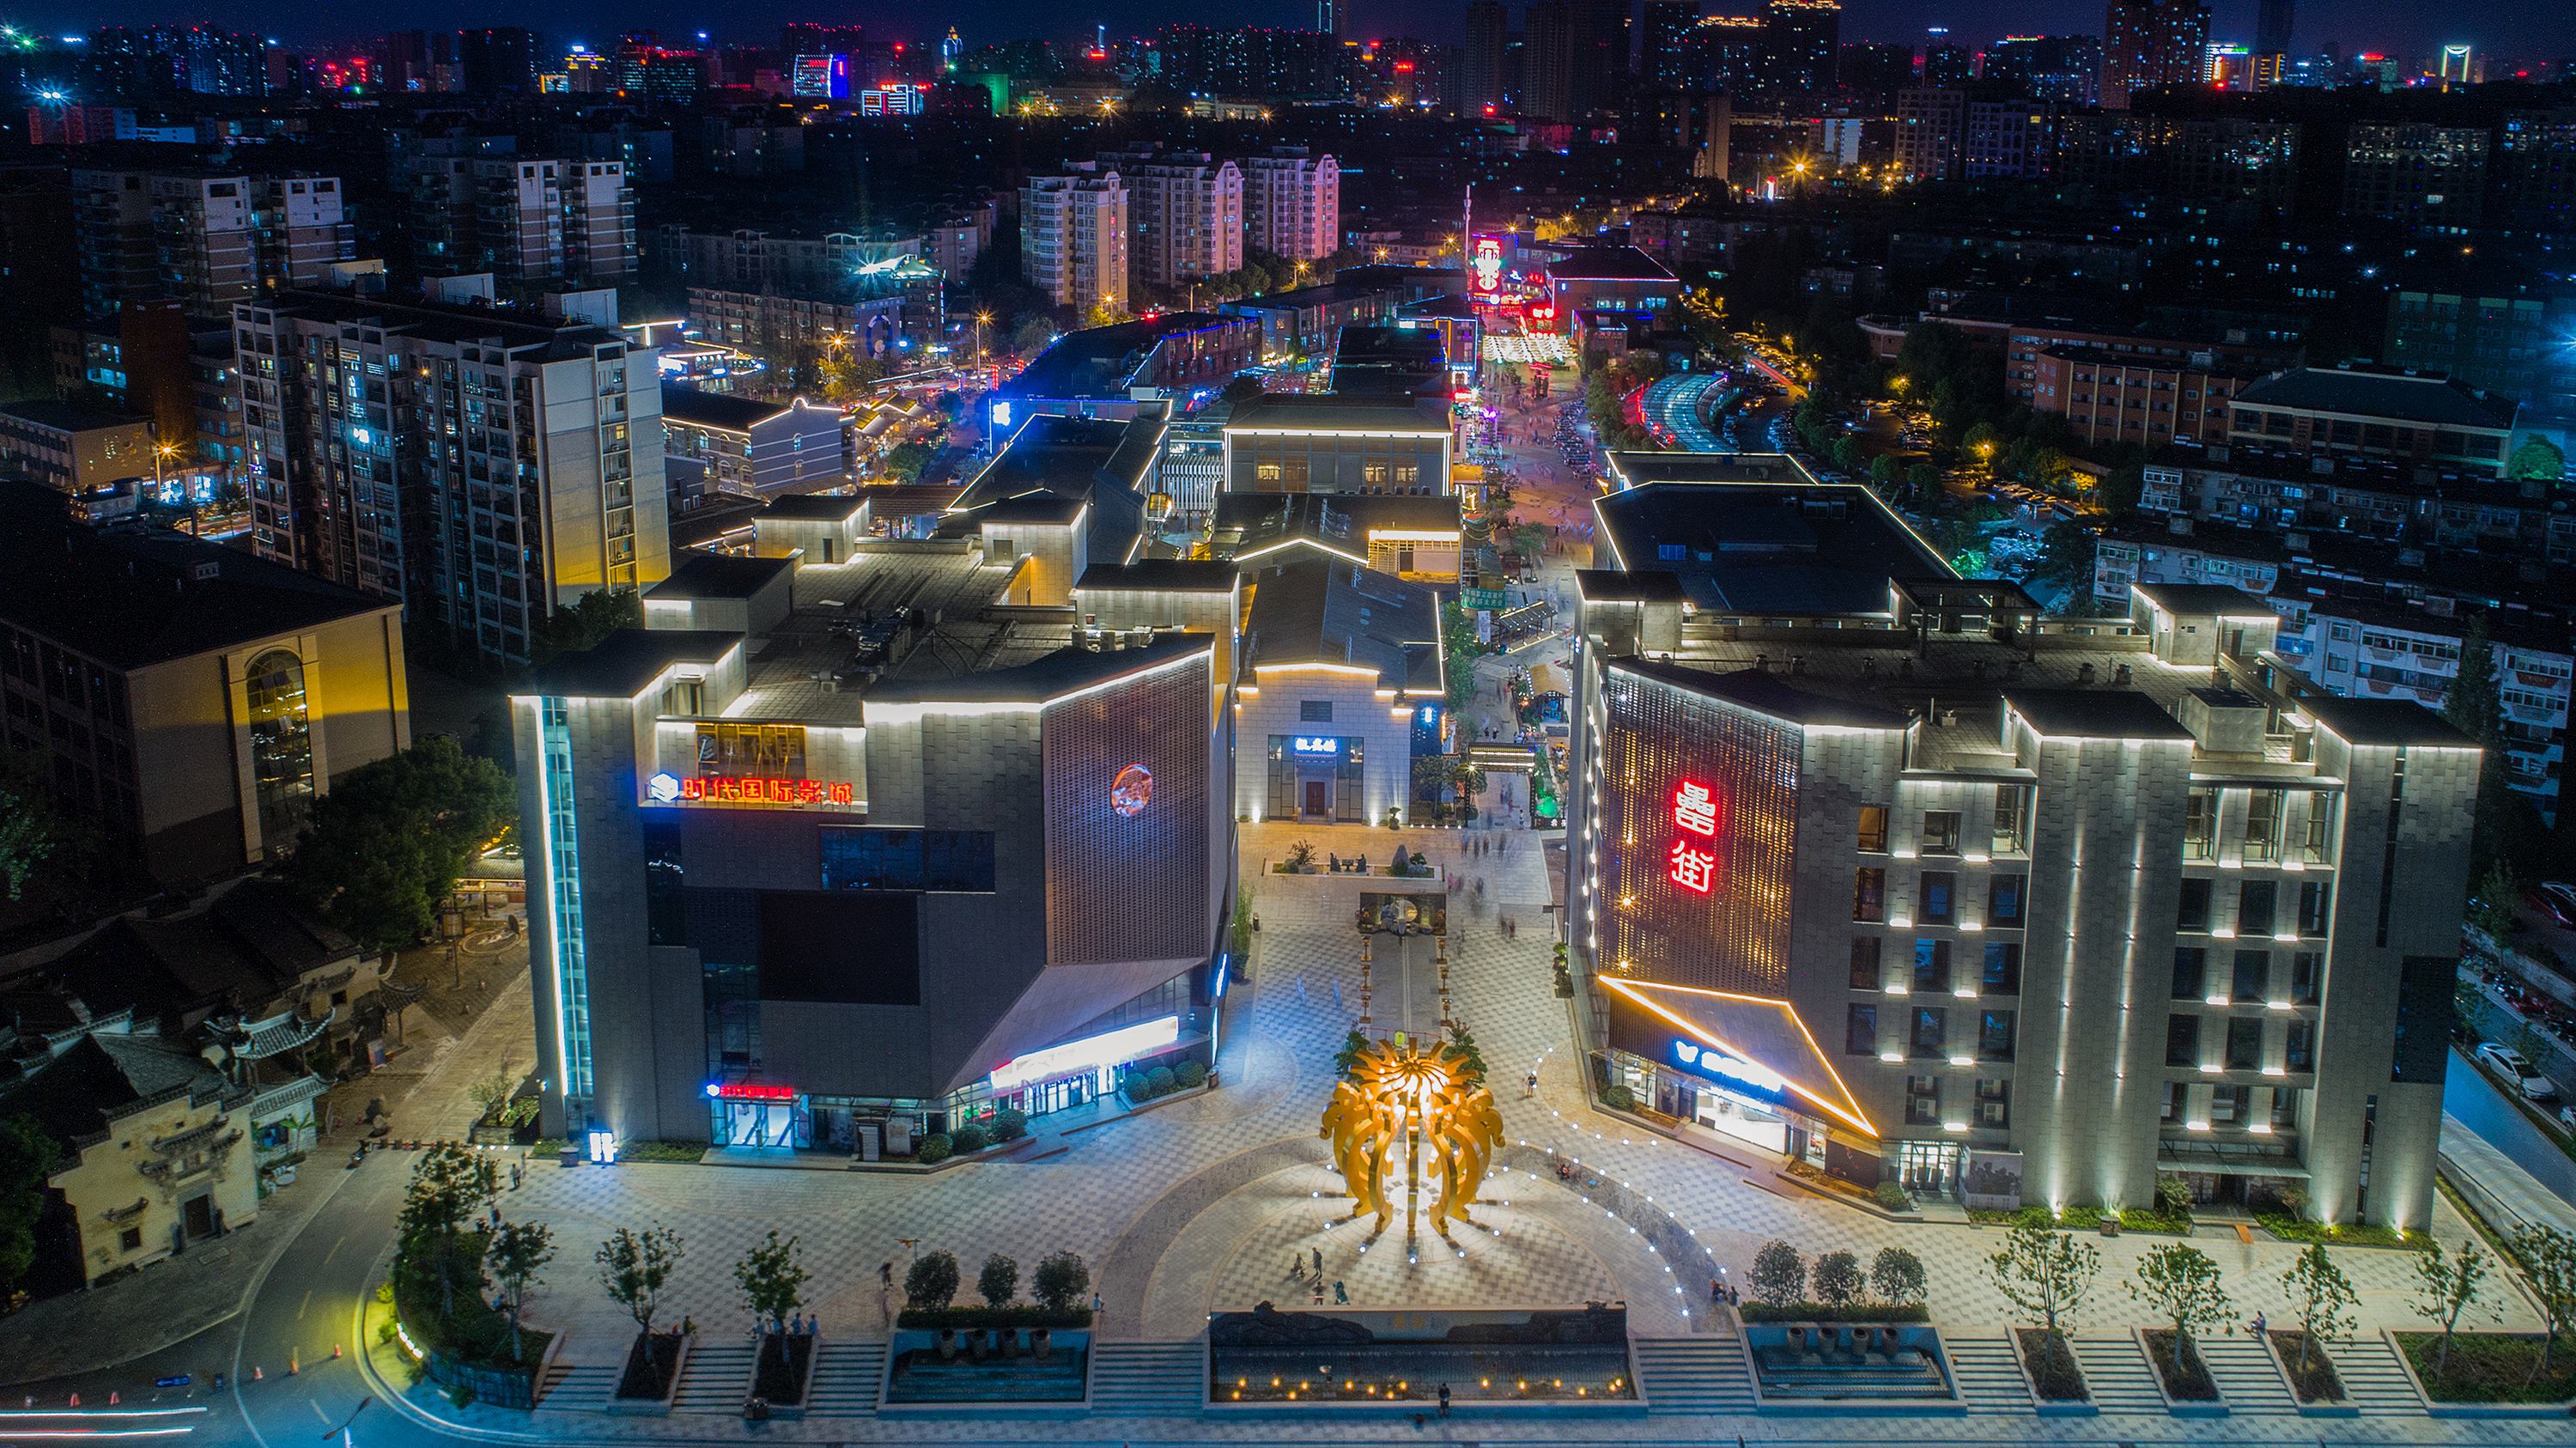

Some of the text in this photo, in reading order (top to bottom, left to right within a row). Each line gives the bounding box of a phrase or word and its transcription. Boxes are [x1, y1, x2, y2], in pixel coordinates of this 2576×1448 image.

[683, 777, 853, 805] 时代国际影城
